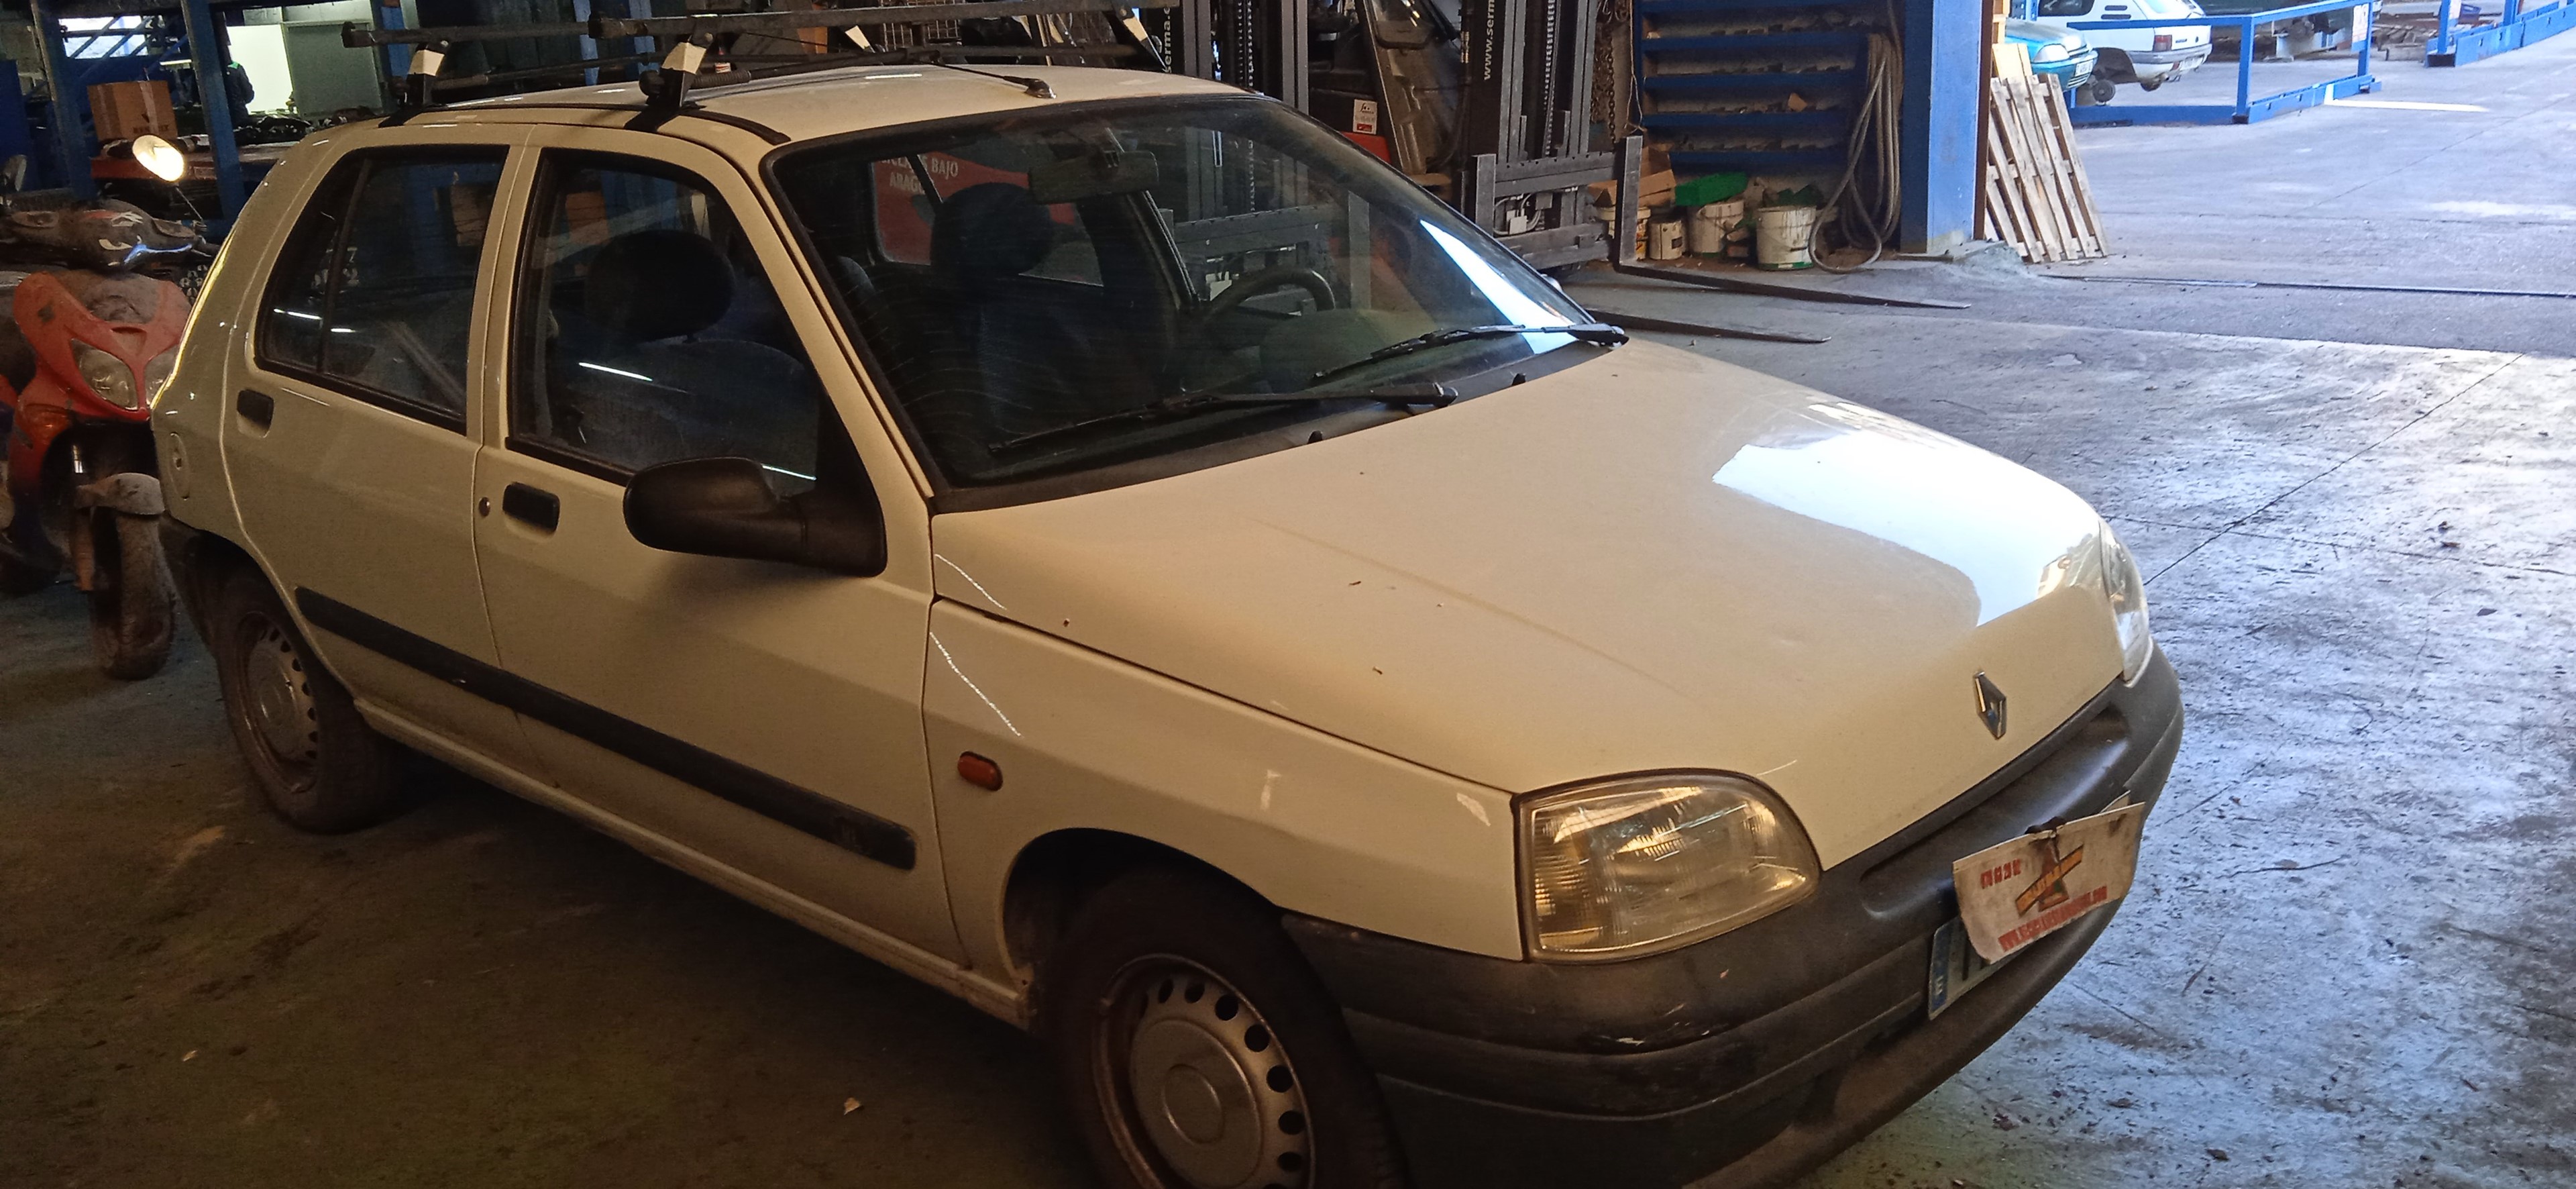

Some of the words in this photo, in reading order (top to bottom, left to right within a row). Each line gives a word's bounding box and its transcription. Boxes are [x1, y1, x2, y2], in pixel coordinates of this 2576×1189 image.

[1163, 7, 1172, 73] serma.e
[1484, 0, 1495, 80] www.serm
[931, 157, 959, 180] BAJO
